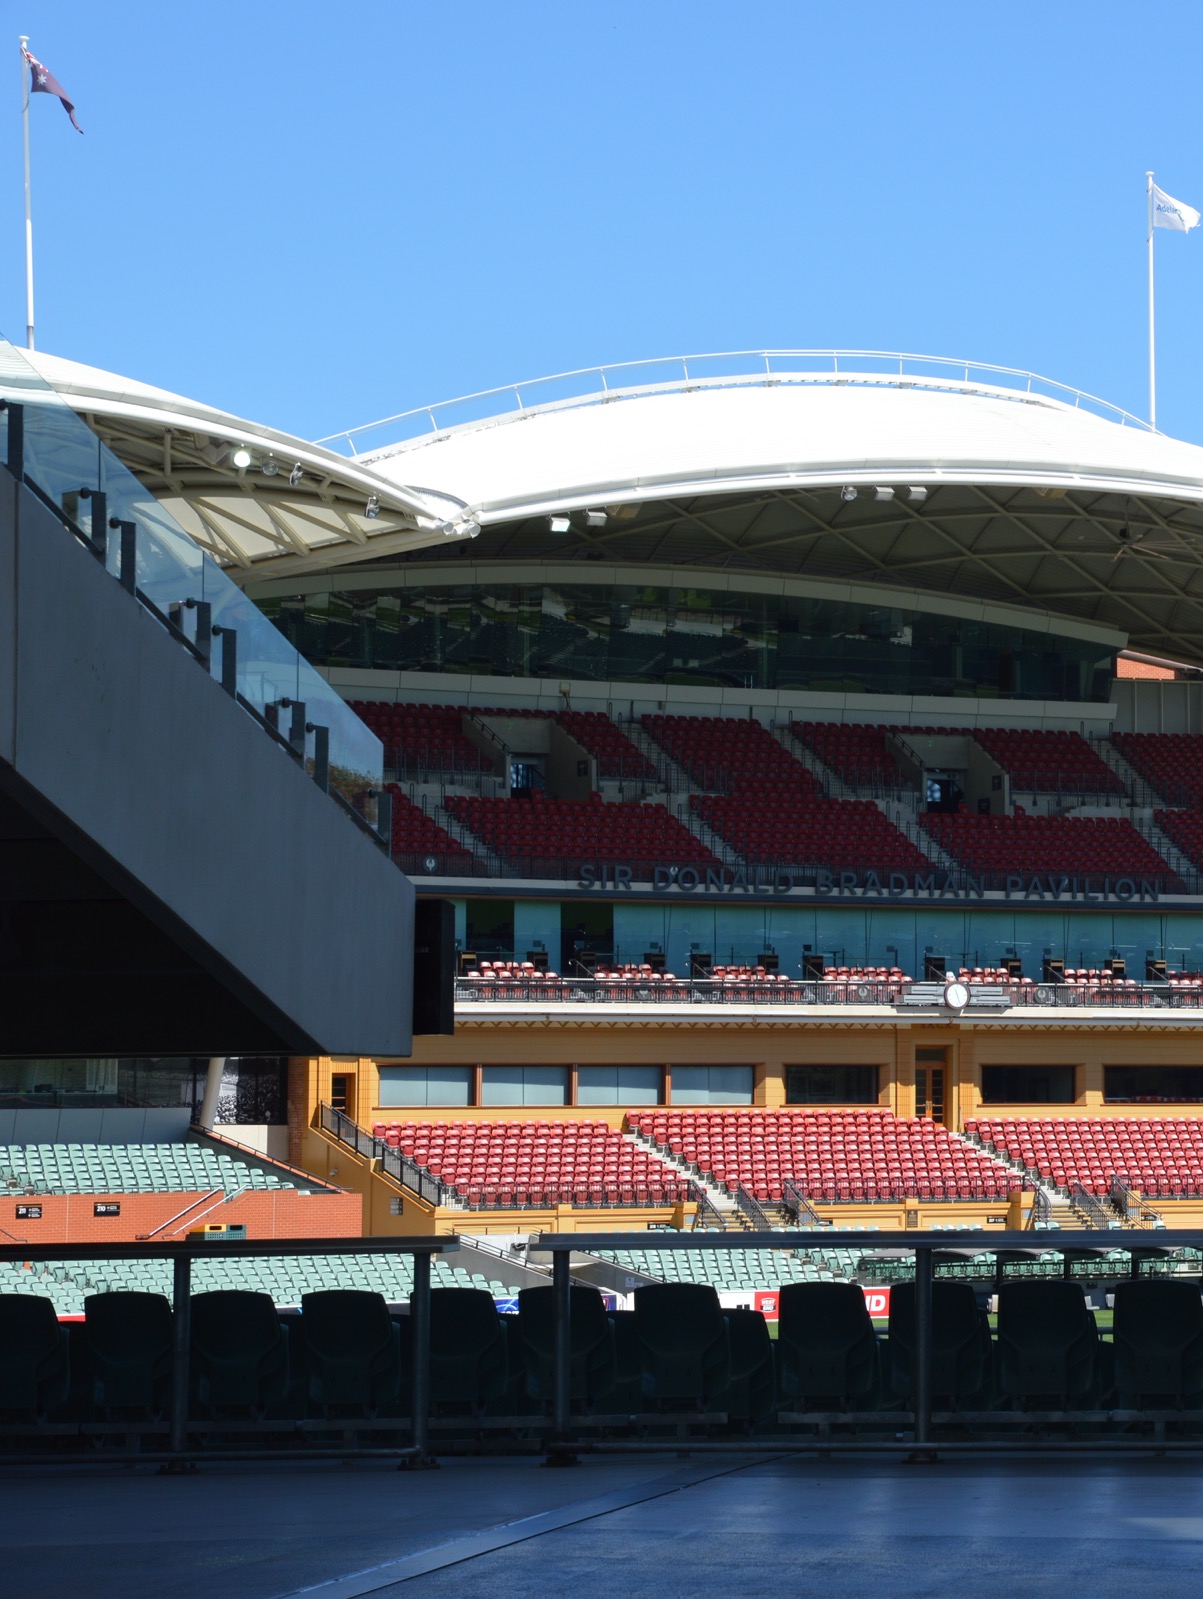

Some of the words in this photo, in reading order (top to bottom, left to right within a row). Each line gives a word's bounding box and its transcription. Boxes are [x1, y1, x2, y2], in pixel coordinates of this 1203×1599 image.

[577, 864, 633, 890] SIR
[652, 866, 795, 894] DONALD
[814, 870, 985, 898] BRADMAN
[1005, 875, 1160, 902] PAVILION
